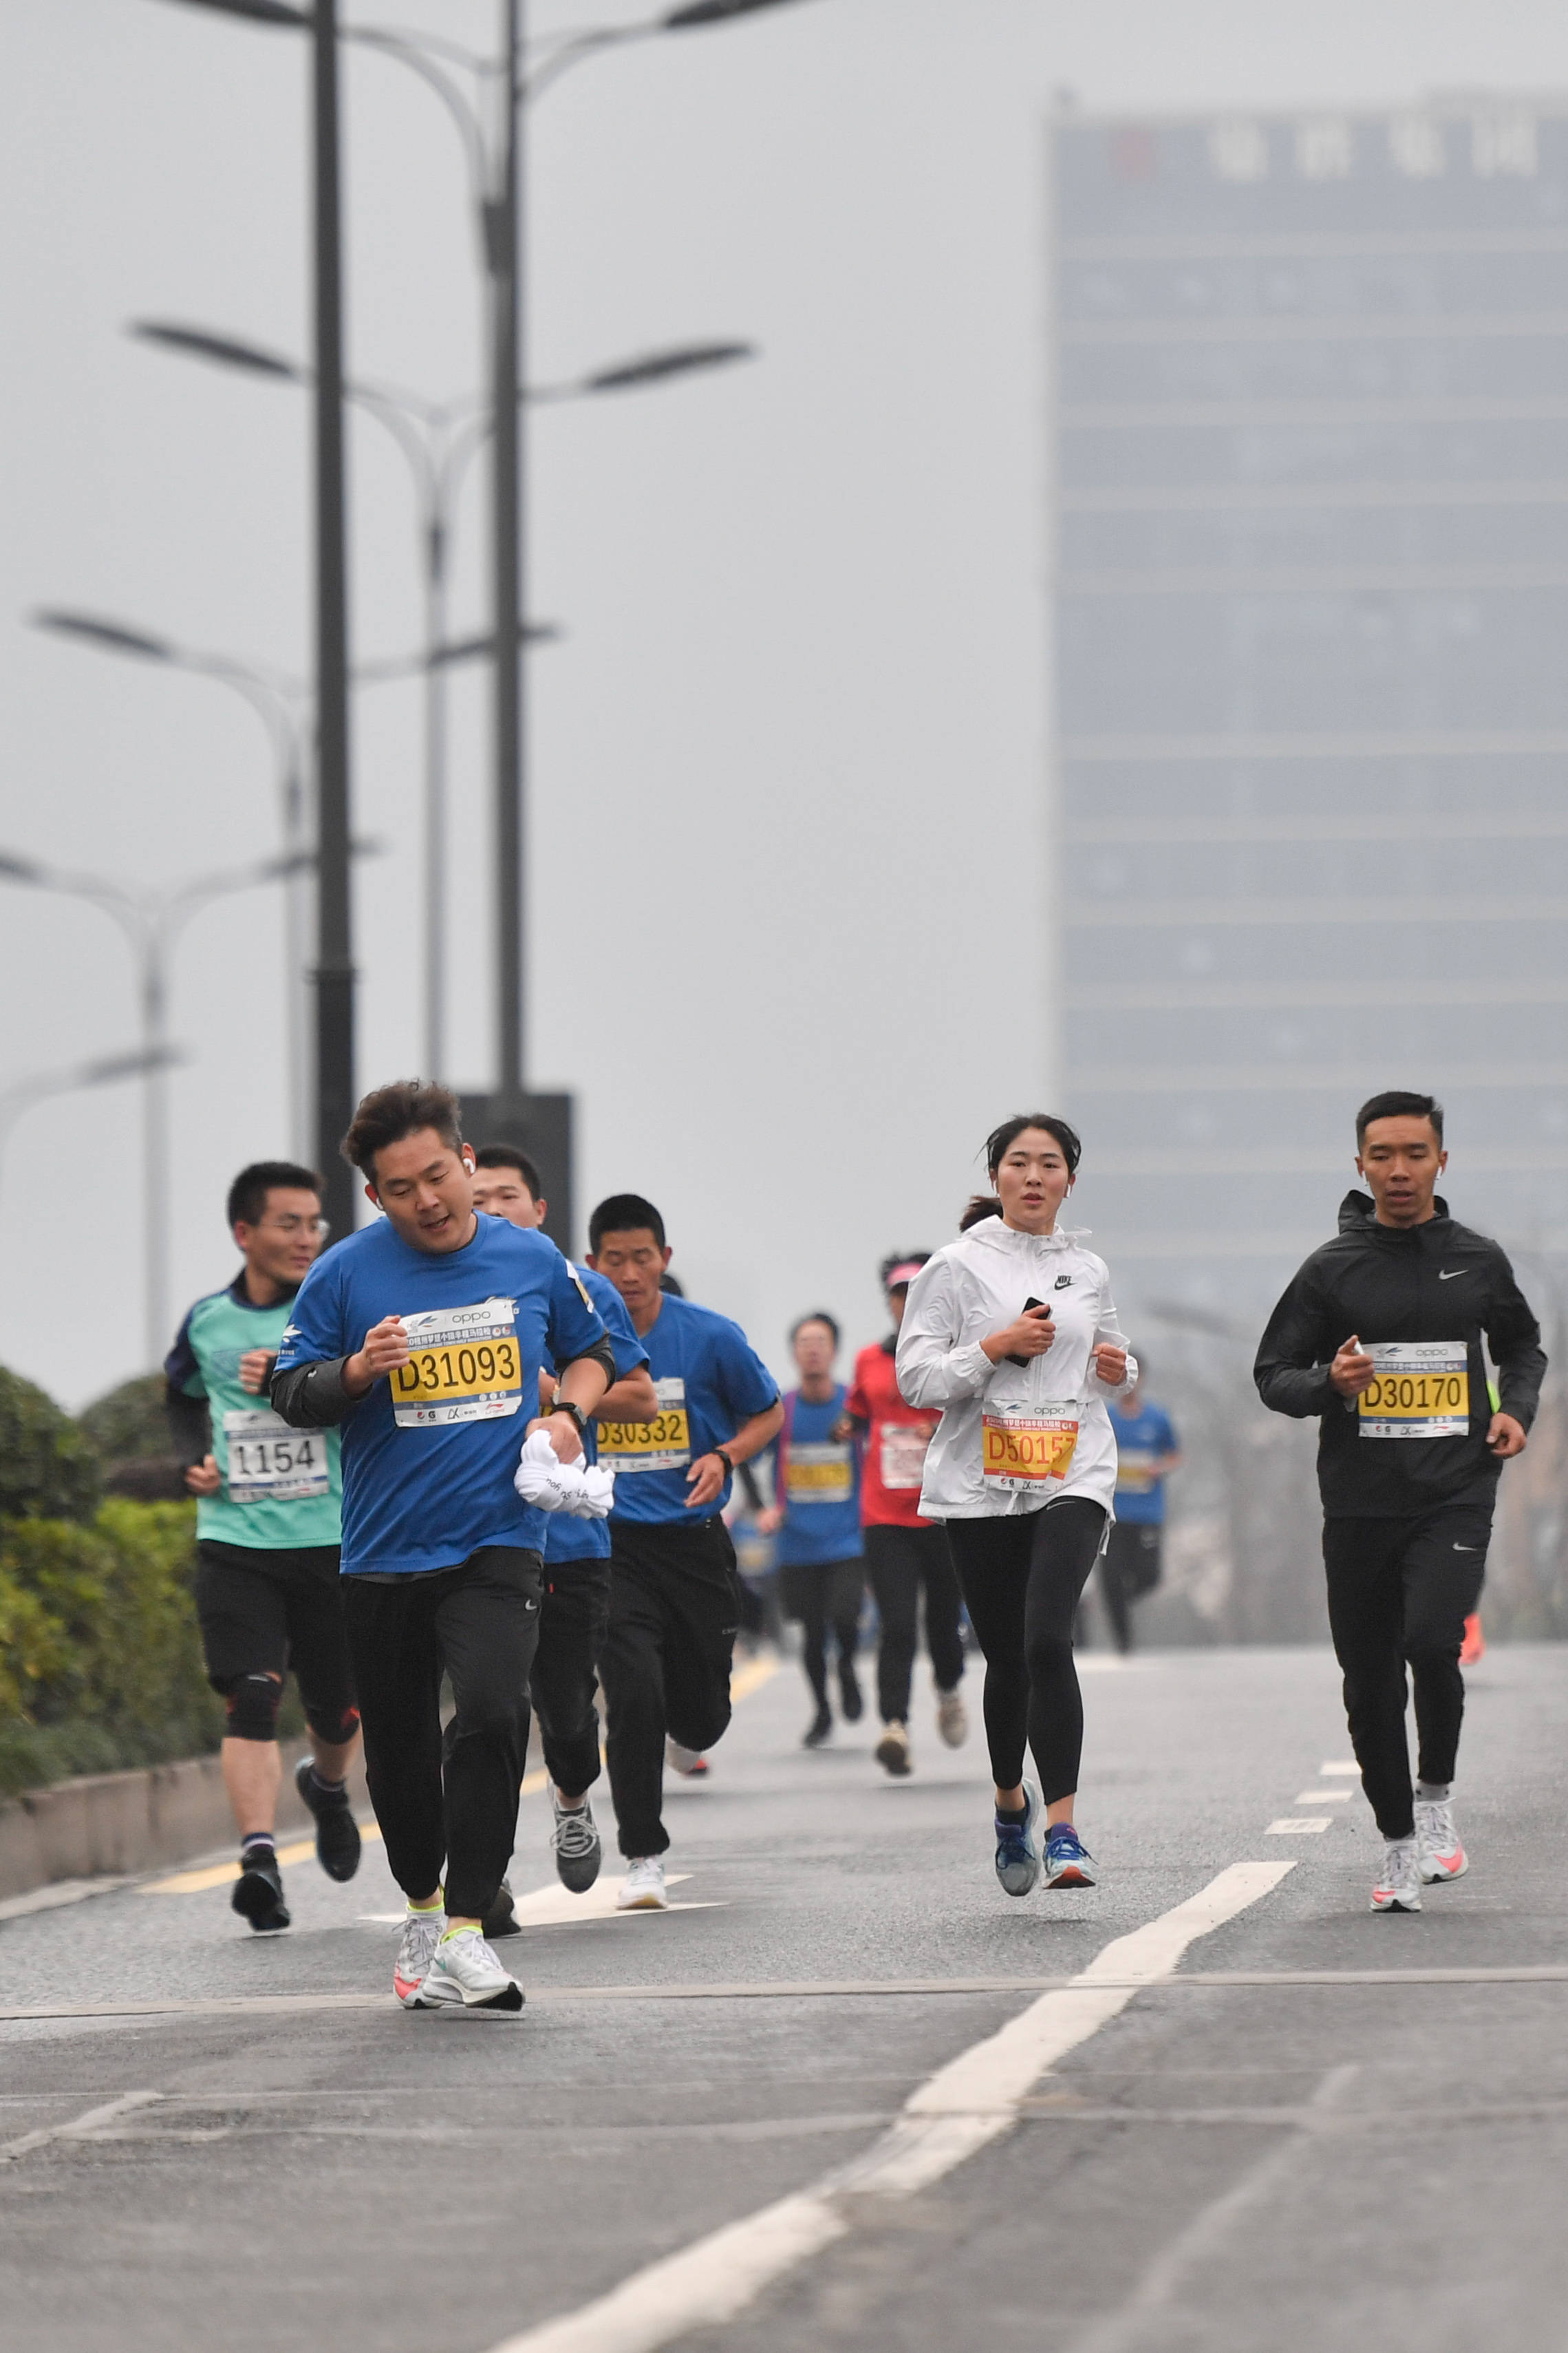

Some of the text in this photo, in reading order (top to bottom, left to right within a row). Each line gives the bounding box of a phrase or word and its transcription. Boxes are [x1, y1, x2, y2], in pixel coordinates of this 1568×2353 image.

[1057, 1275, 1073, 1284] NIKE
[452, 1310, 491, 1325] oppo
[398, 1343, 515, 1392] D31093
[1364, 1377, 1461, 1408] D30170
[1034, 1407, 1066, 1416] oppo
[237, 1440, 314, 1474] 1154
[989, 1431, 1075, 1465] D50157
